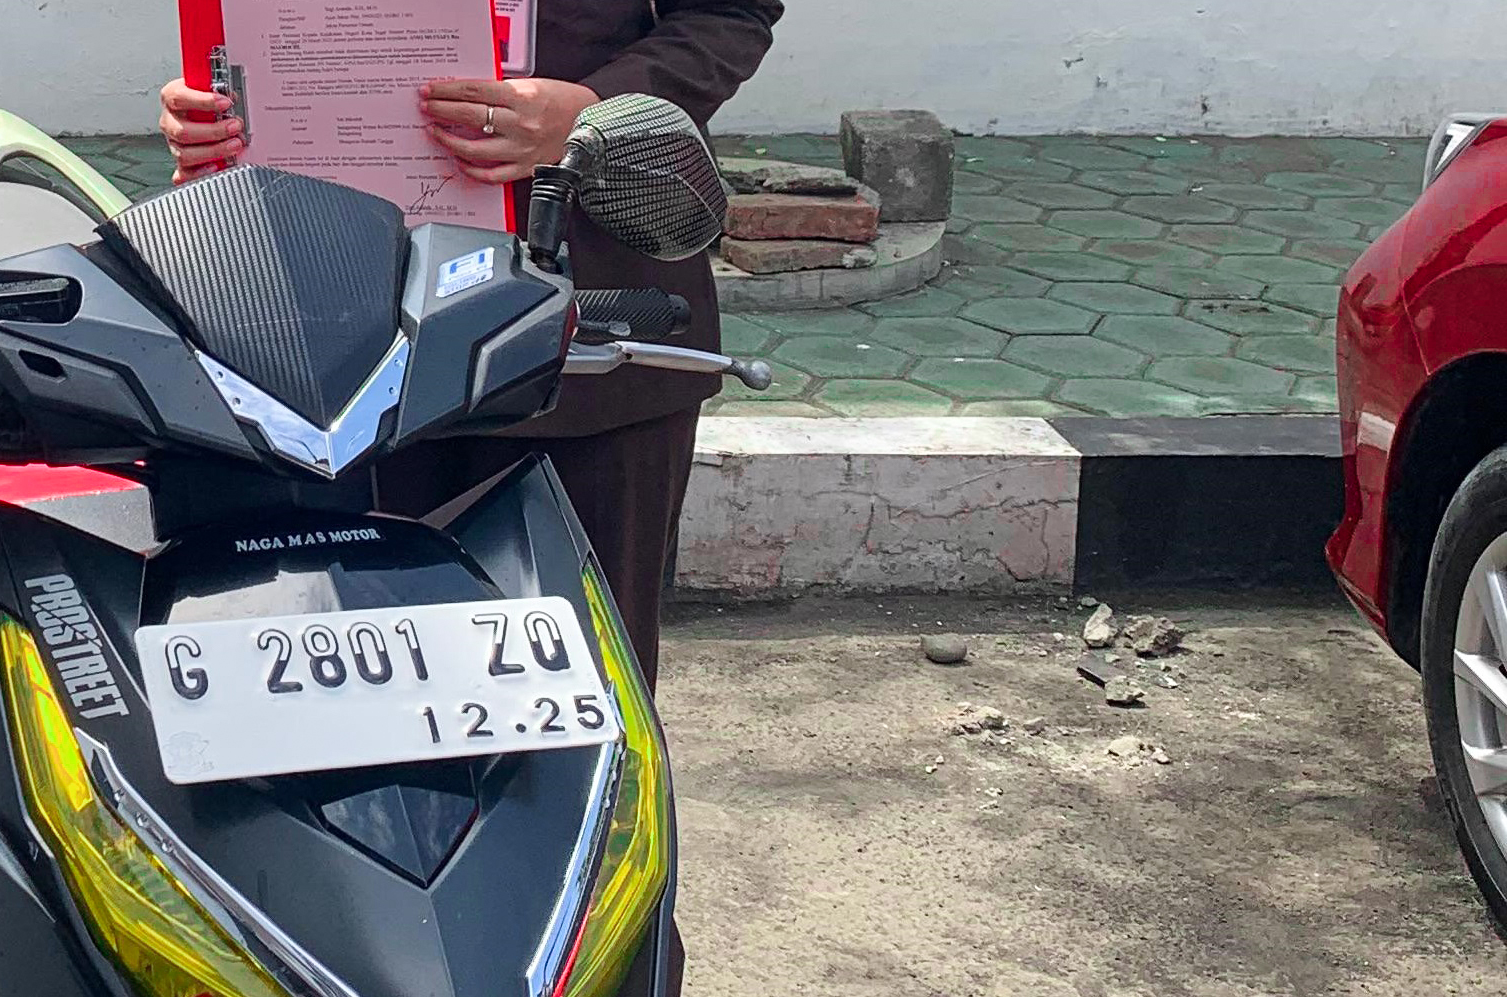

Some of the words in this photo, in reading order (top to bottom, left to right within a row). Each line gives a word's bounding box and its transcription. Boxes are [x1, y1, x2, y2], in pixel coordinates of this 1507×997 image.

[235, 537, 285, 552] NAGA
[287, 532, 326, 547] MAS
[328, 528, 381, 543] MOTOR
[24, 573, 130, 719] PROSTREET
[165, 635, 209, 700] G
[257, 618, 429, 694] 2801
[471, 610, 572, 676] ZQ
